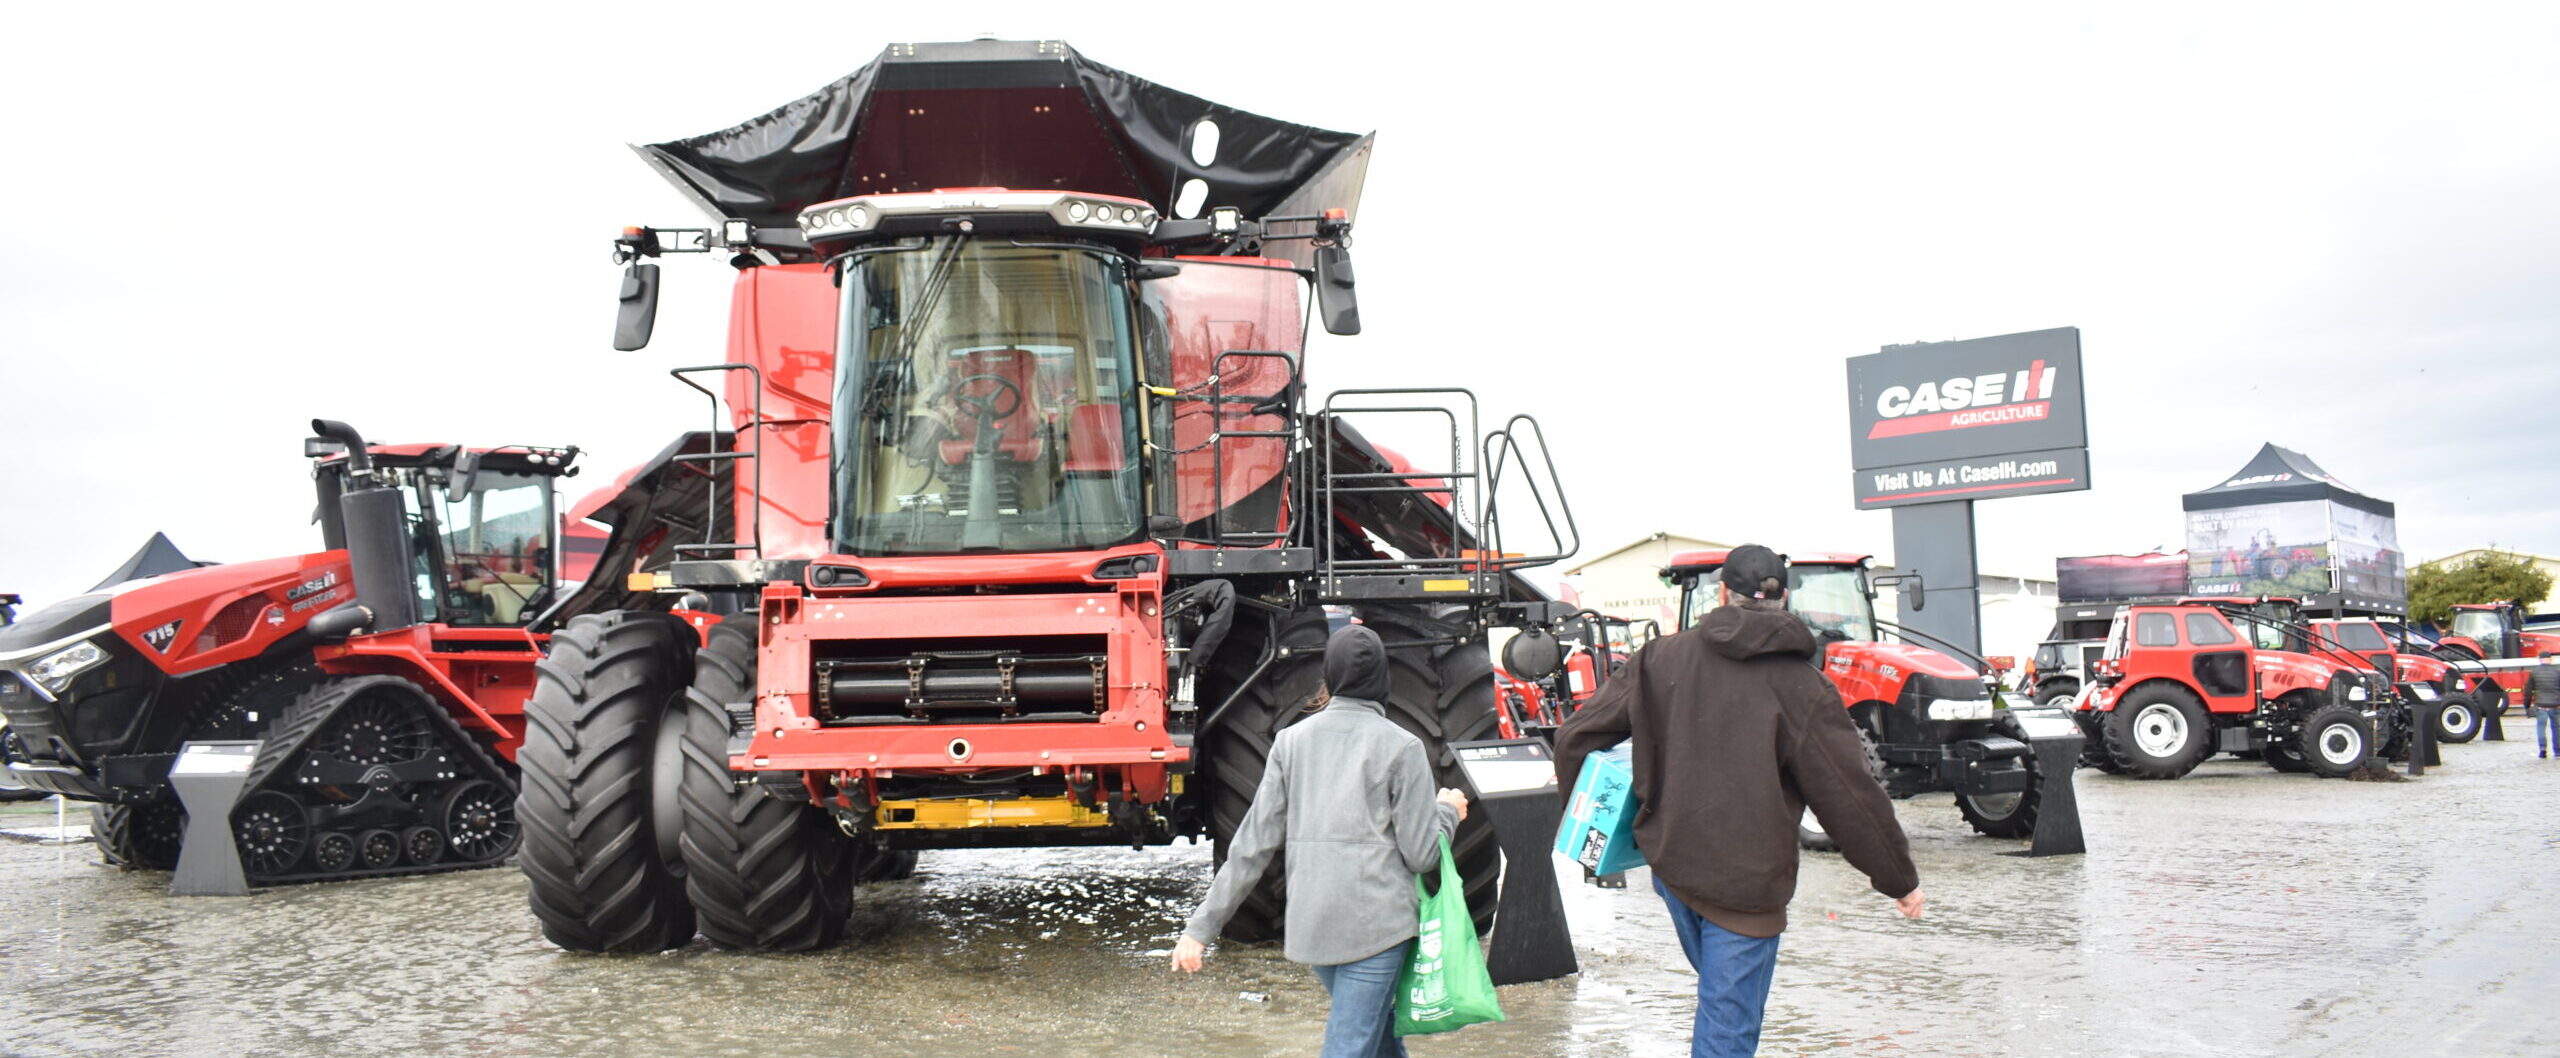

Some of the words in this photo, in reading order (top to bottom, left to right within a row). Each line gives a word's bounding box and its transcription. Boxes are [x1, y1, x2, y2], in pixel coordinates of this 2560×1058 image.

[1877, 373, 2007, 418] CASE
[2012, 359, 2056, 402] IH
[1951, 404, 2043, 426] AGRICULTURE
[1875, 471, 1909, 492] Visit
[1913, 470, 1933, 488] Us
[1938, 467, 1956, 485] At
[1960, 460, 2057, 483] CaseIH.com
[286, 578, 325, 601] CASE
[2197, 584, 2229, 594] CASE
[1604, 600, 1629, 609] FARM
[1633, 597, 1667, 607] CREDIT
[147, 623, 175, 645] 715
